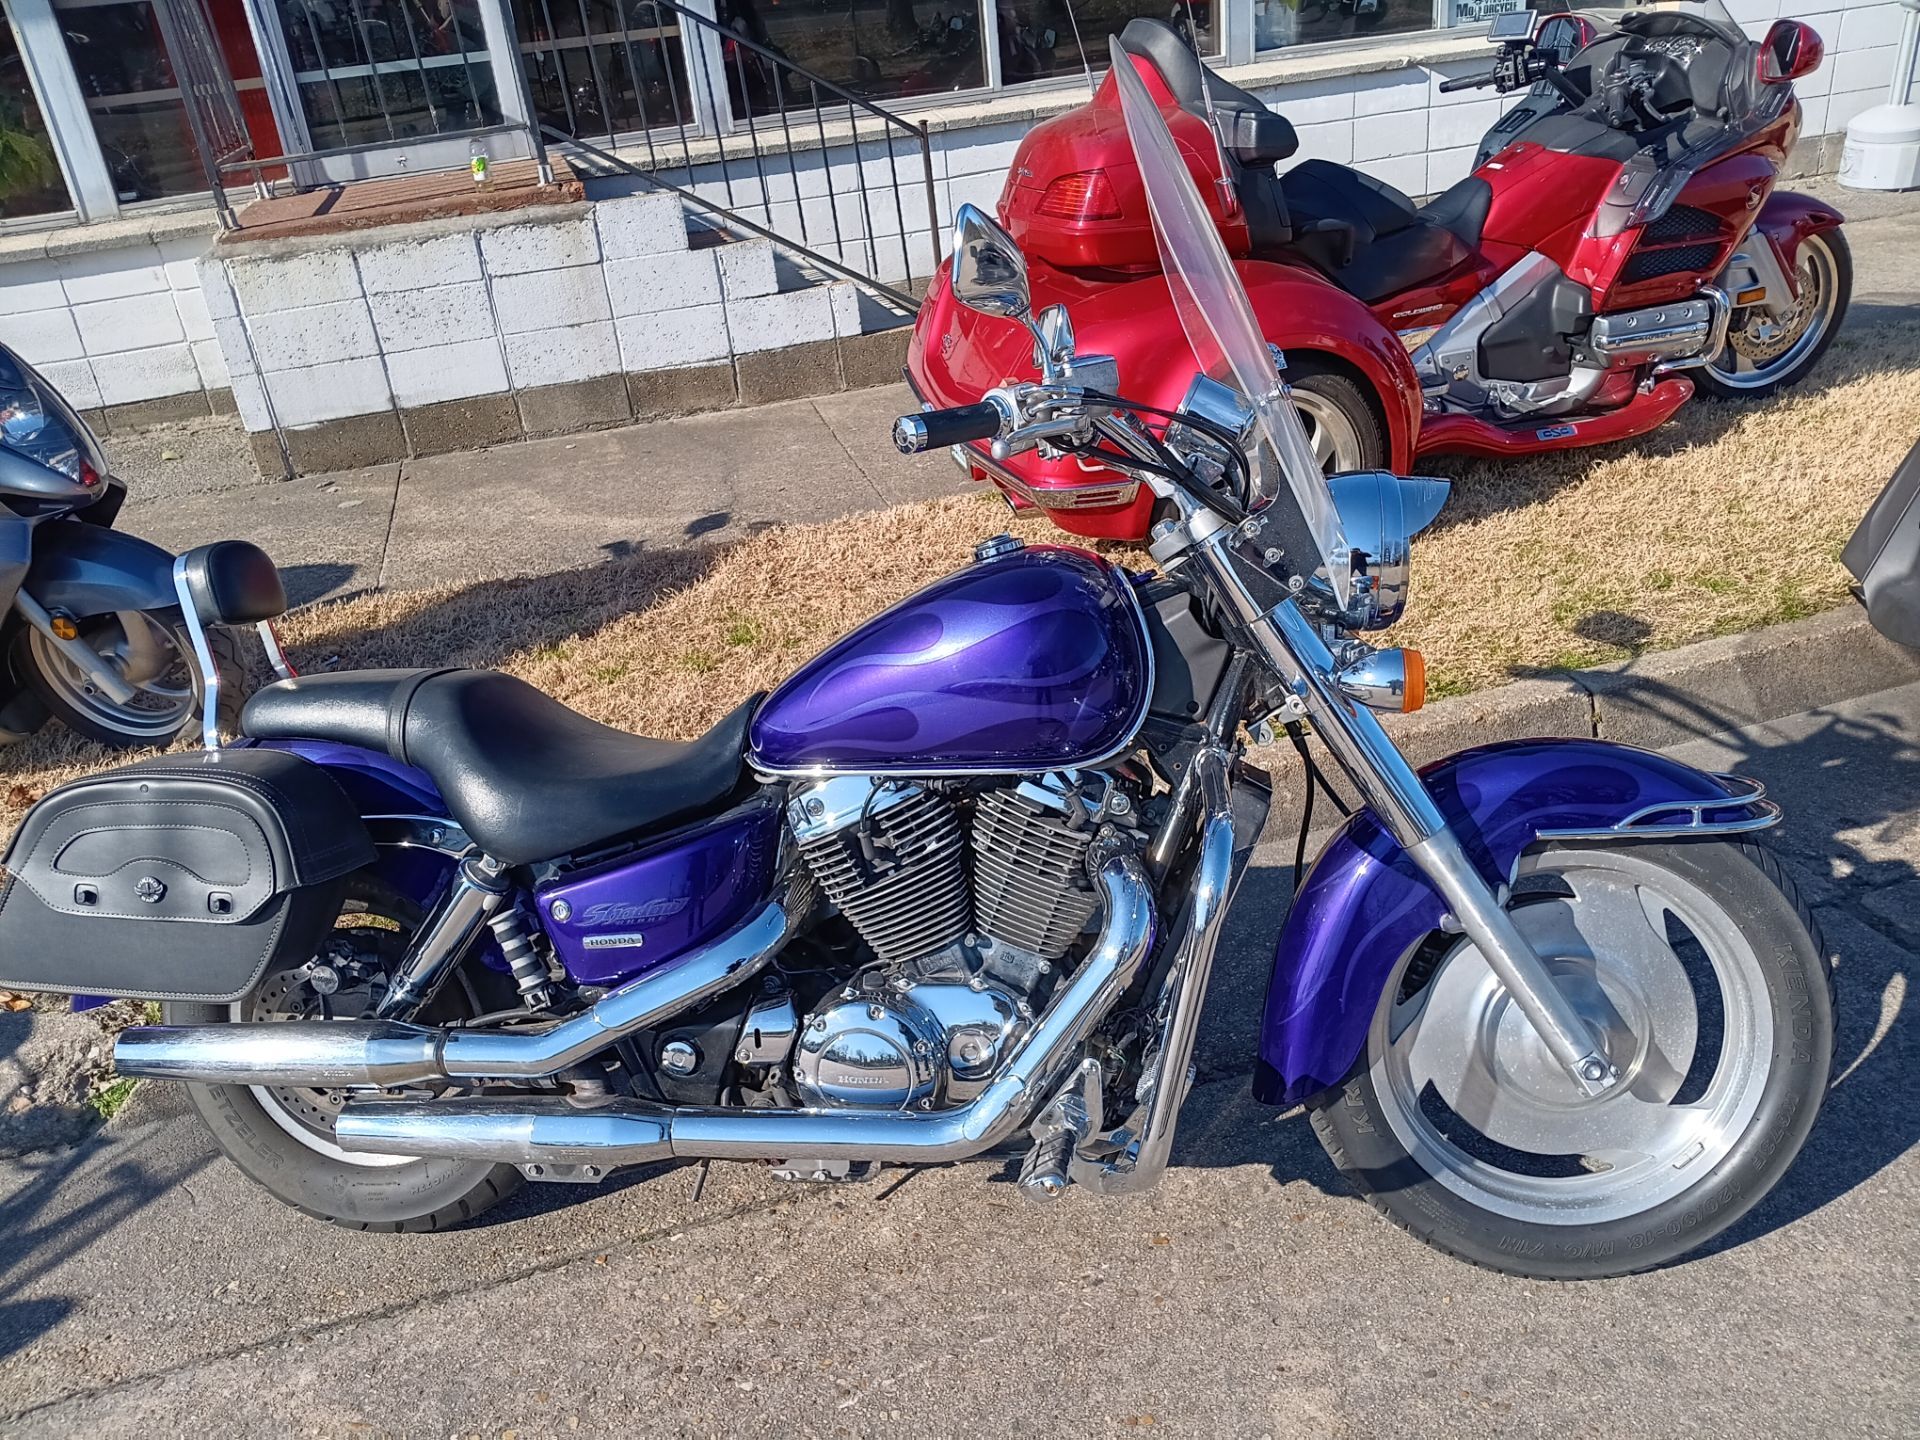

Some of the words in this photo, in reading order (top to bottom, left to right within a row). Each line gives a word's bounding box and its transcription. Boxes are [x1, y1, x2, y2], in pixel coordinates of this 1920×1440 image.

[589, 937, 637, 947] HONDA
[1773, 942, 1814, 1066] KENDA
[206, 1083, 285, 1170] ETZELER
